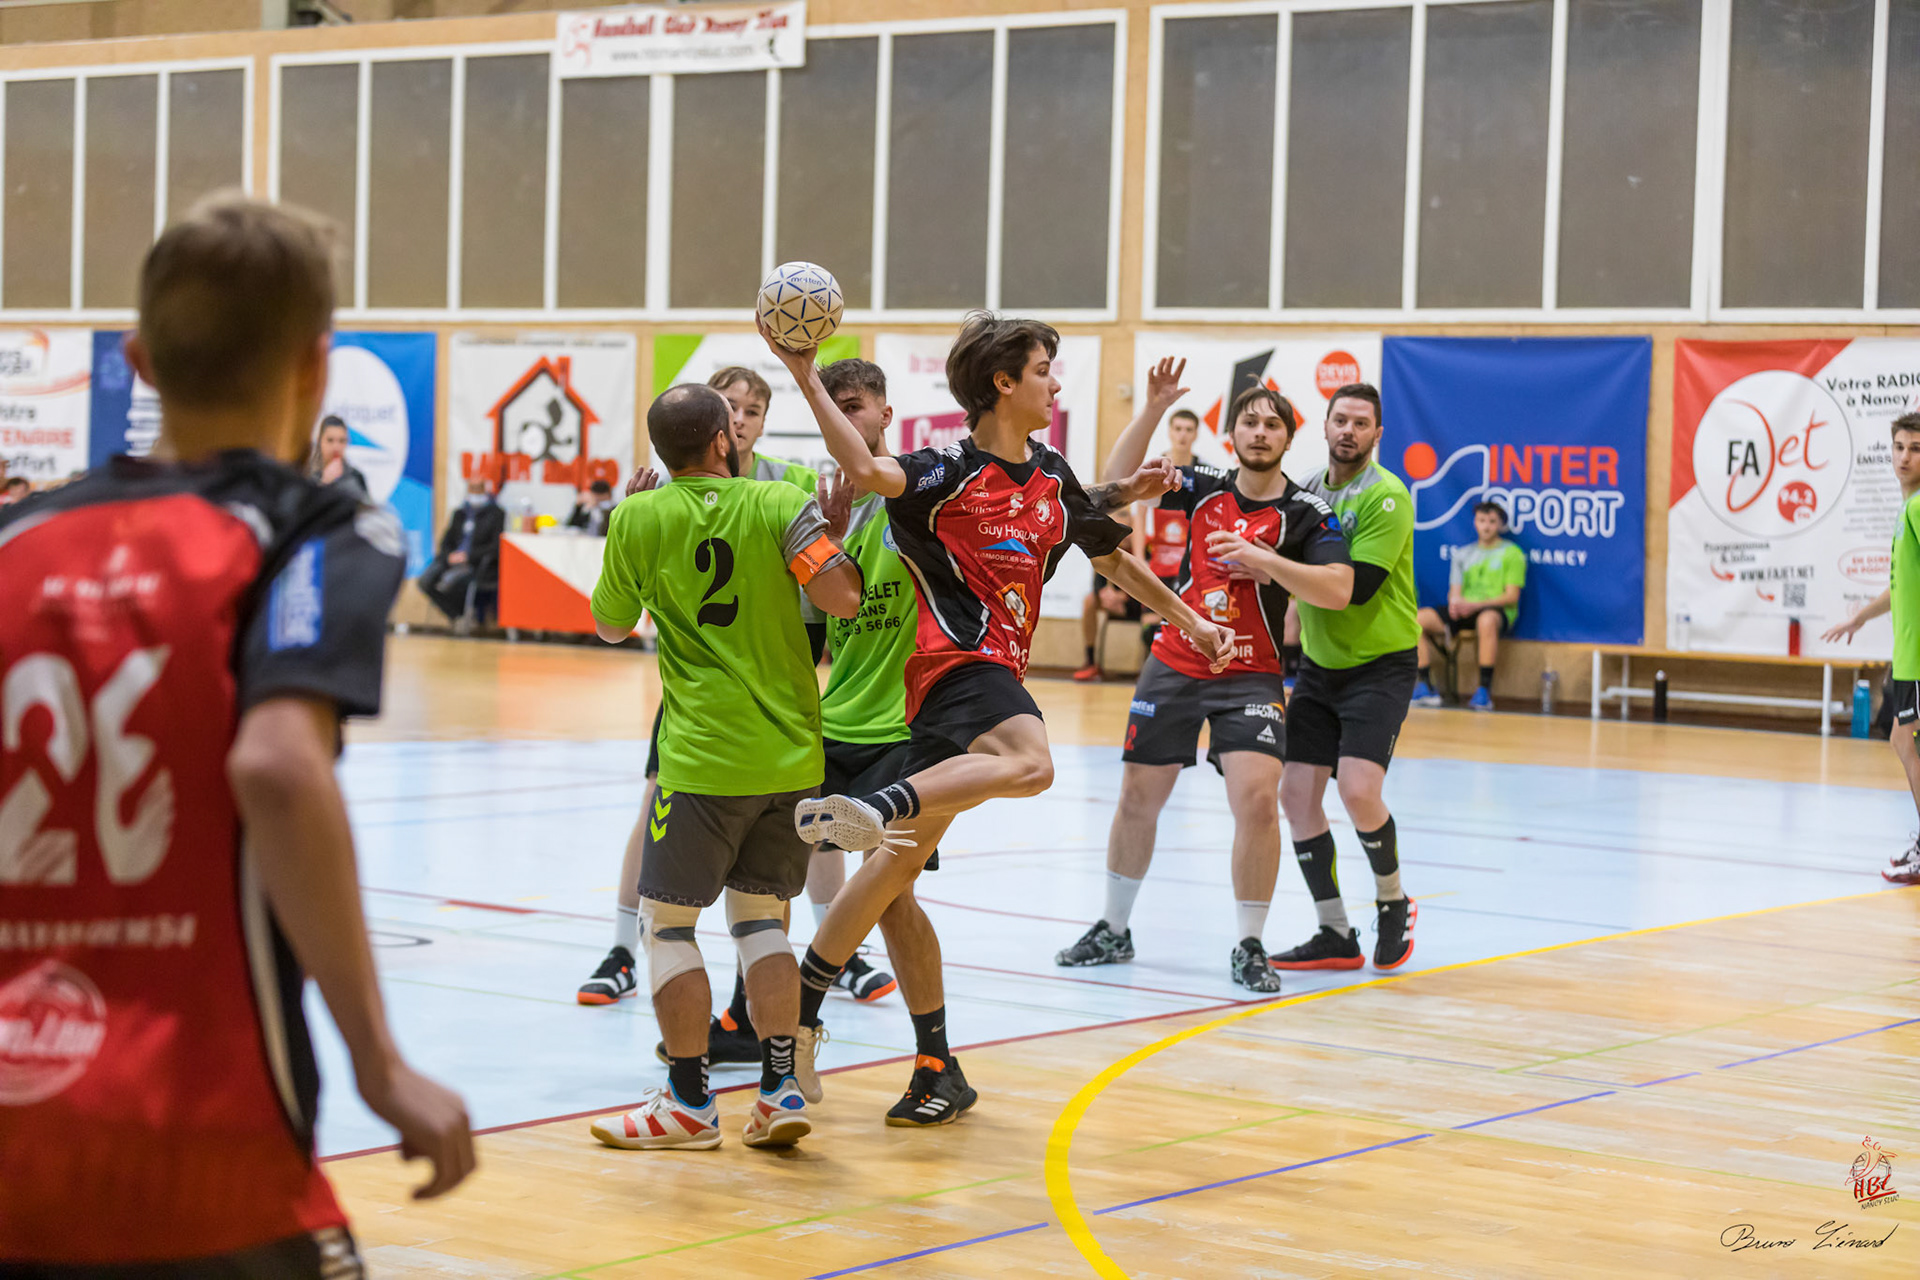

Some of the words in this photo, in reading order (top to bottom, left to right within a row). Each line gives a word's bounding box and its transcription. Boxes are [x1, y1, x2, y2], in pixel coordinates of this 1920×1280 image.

[1826, 377, 1872, 392] Votre
[1861, 392, 1909, 409] Nancy
[1489, 444, 1619, 486] INTER
[978, 521, 1003, 538] Guy
[1529, 548, 1588, 567] NANCY
[695, 537, 739, 628] 2
[0, 646, 175, 884] 26
